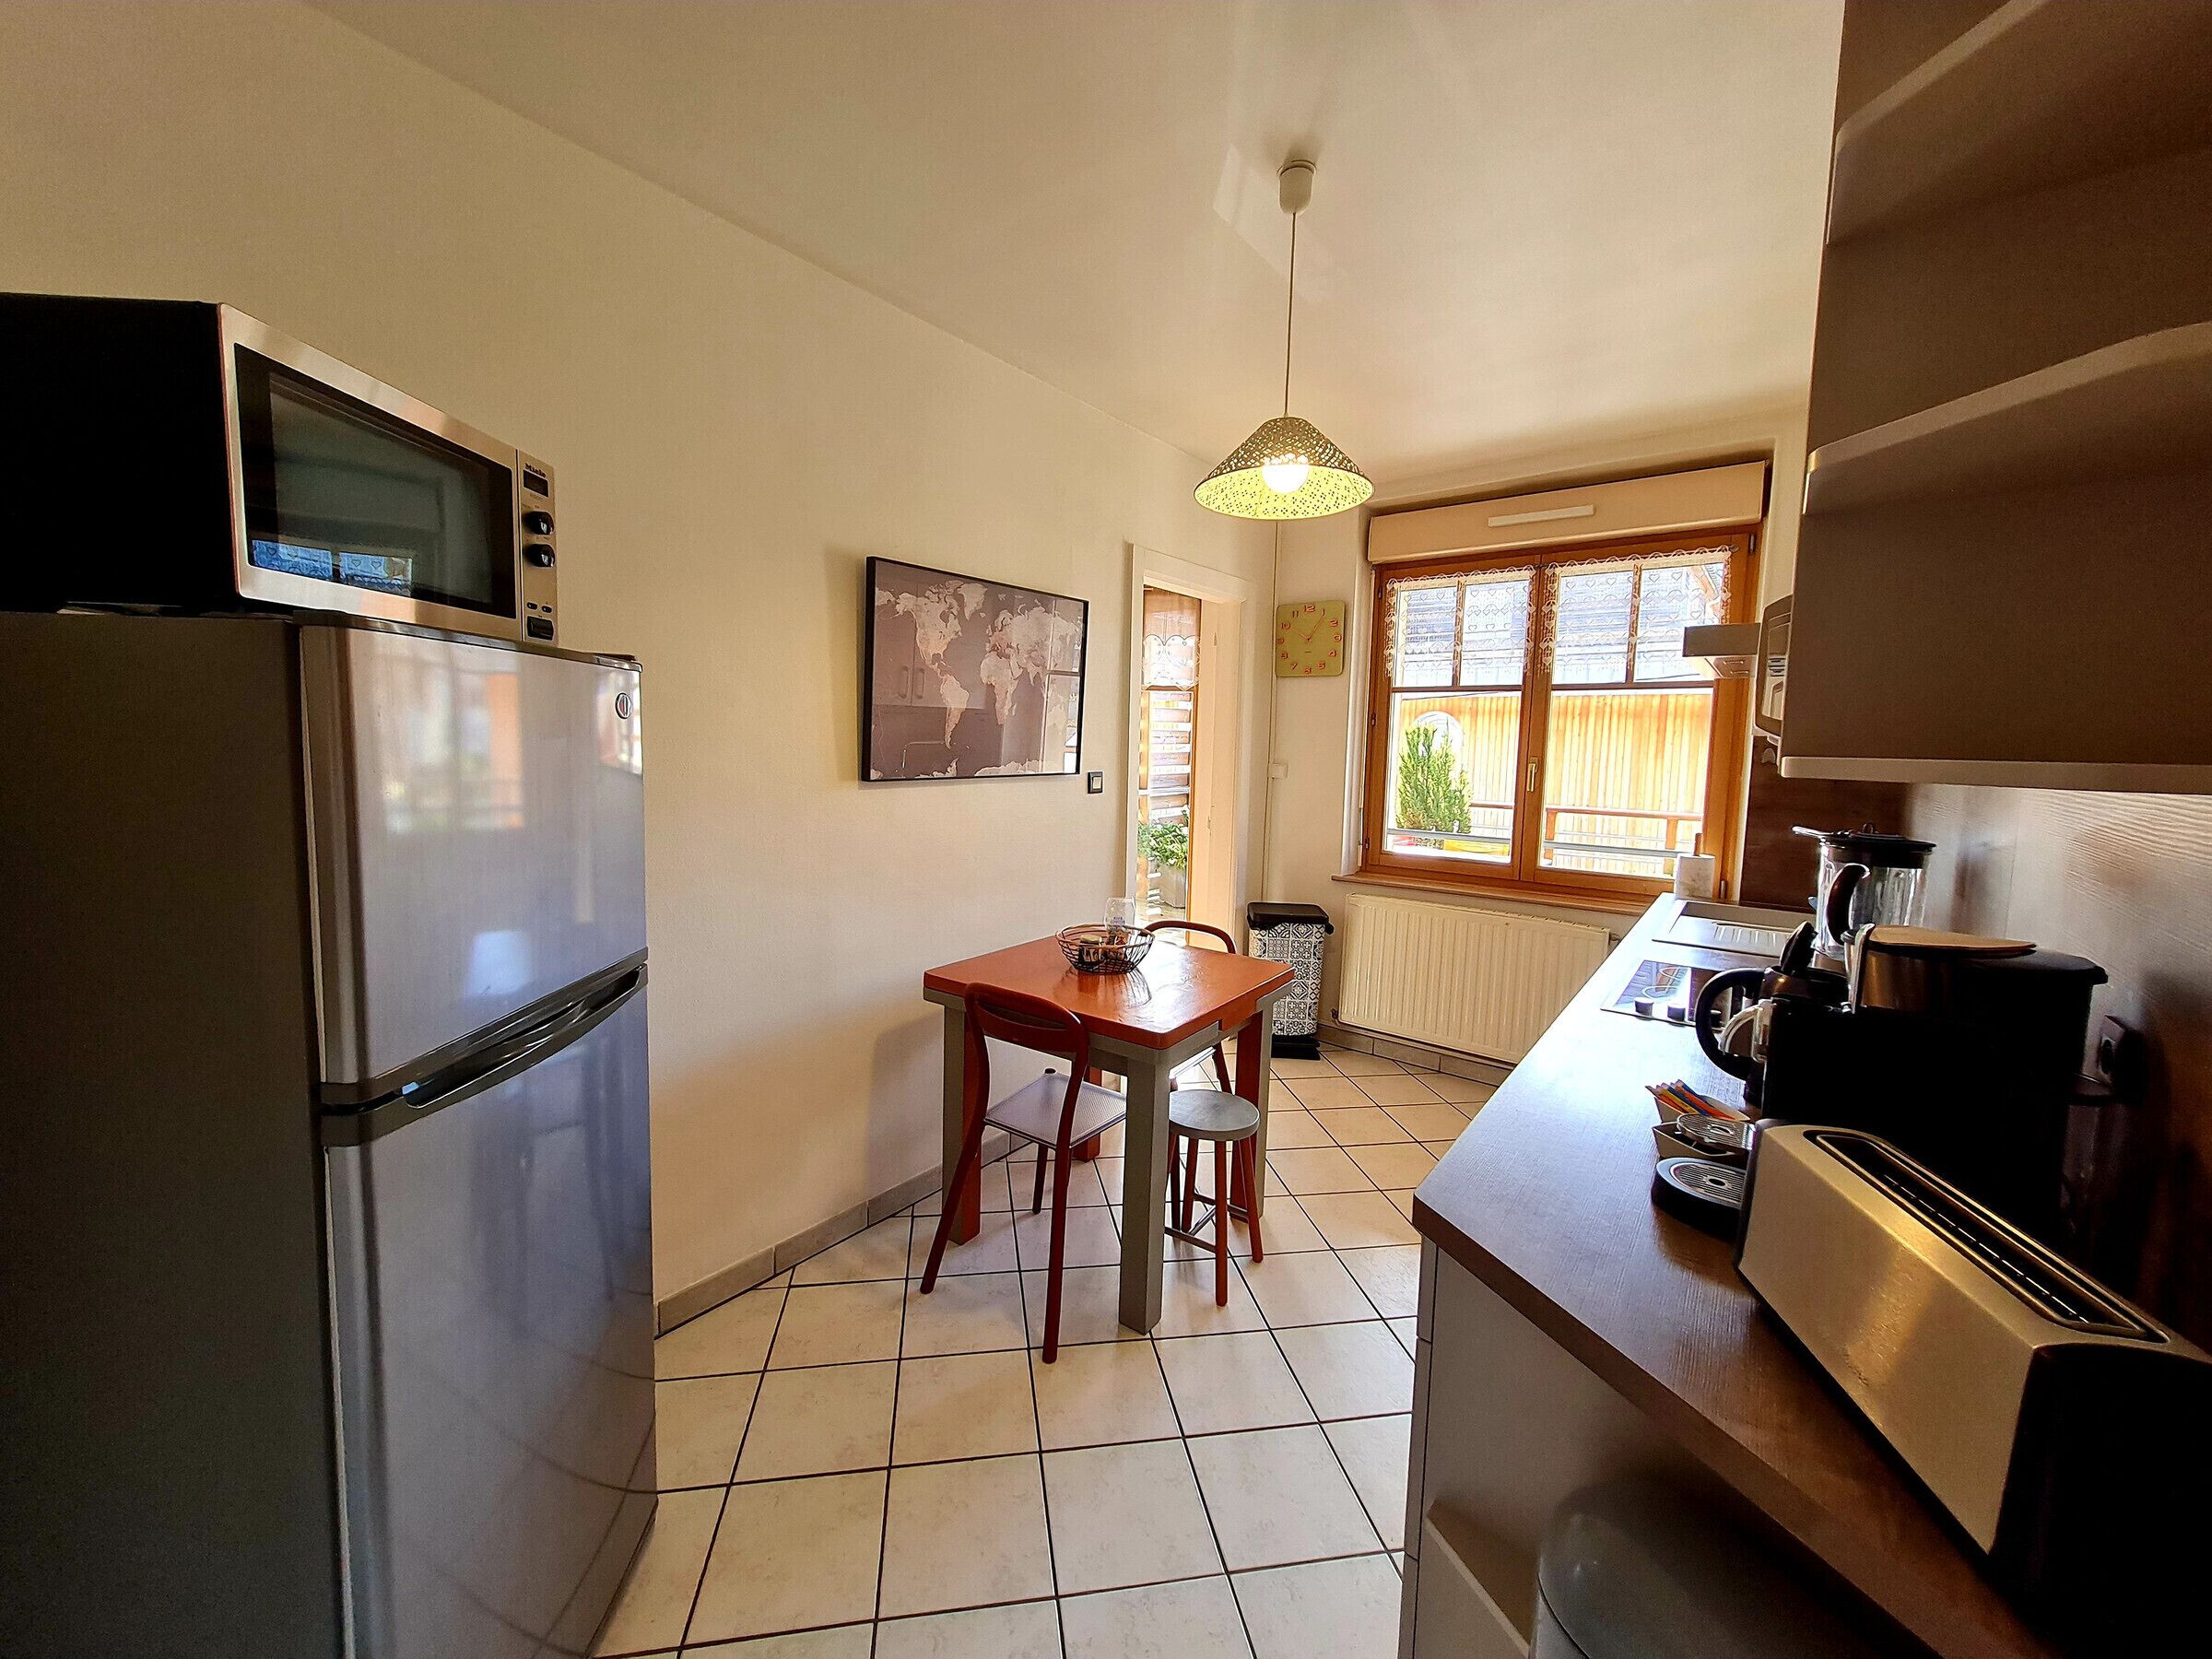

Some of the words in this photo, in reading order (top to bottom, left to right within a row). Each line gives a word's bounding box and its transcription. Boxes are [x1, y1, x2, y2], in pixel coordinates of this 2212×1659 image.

[1303, 604, 1316, 612] 12
[1292, 610, 1300, 618] 11
[1281, 621, 1291, 630] 10
[1330, 618, 1339, 627] 2
[1328, 648, 1337, 658] 4
[1290, 662, 1299, 671] 7
